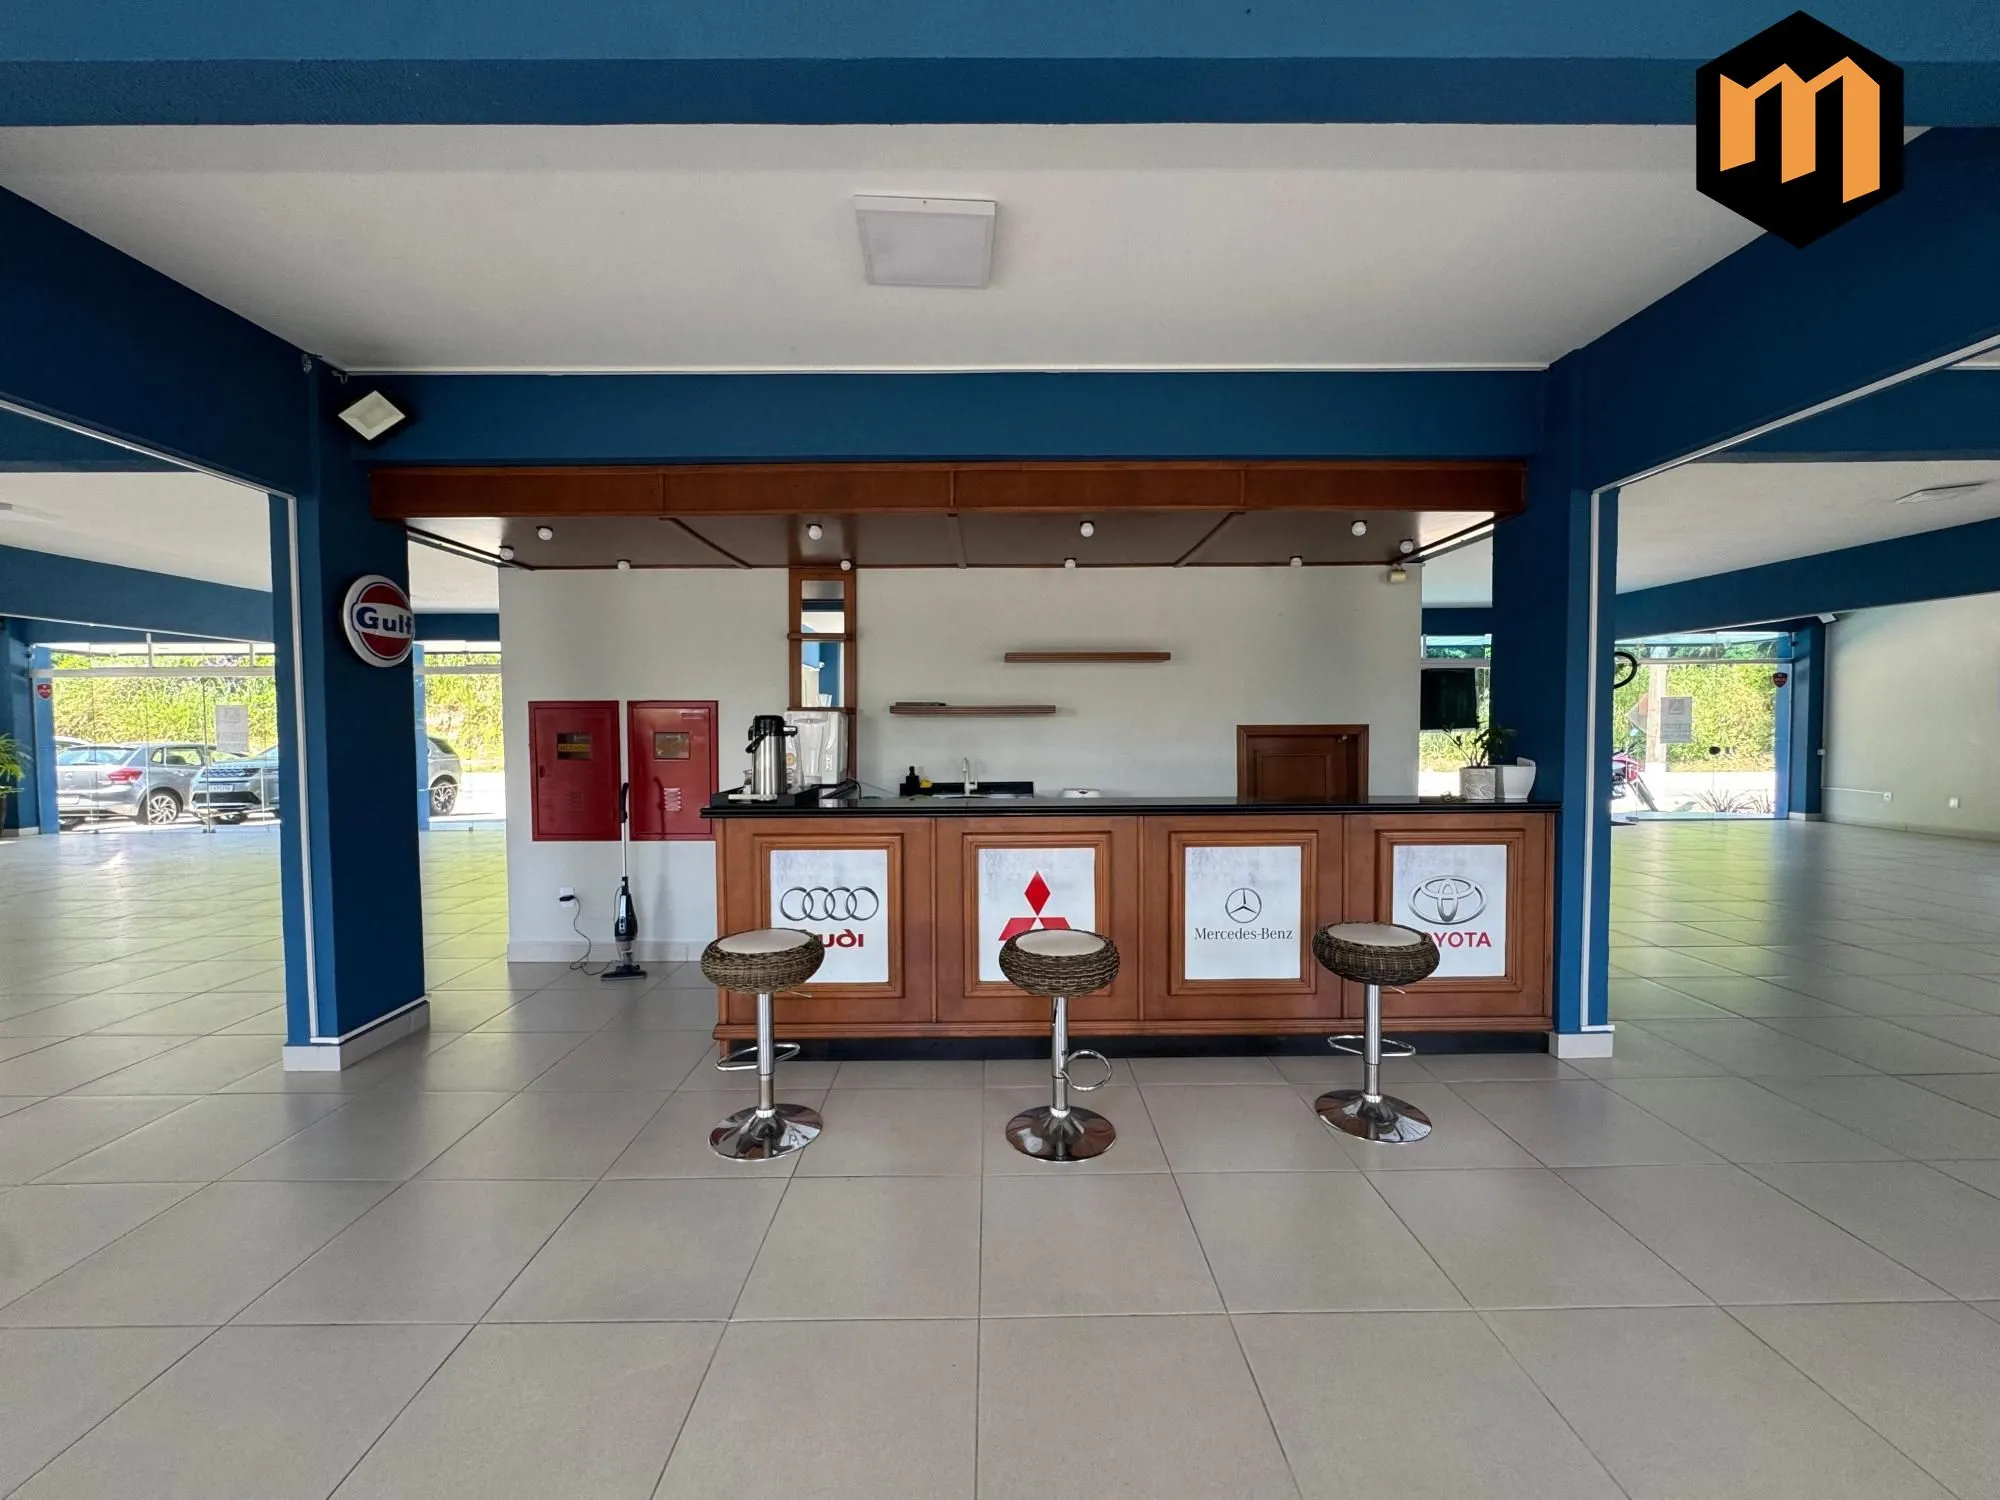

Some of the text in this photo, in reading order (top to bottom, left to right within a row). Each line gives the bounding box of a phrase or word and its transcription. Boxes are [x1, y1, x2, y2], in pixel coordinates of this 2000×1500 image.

[356, 606, 412, 635] Gulf
[818, 929, 864, 948] udi
[1195, 927, 1293, 940] Mercedes-Benz
[1429, 931, 1492, 948] YOTA
